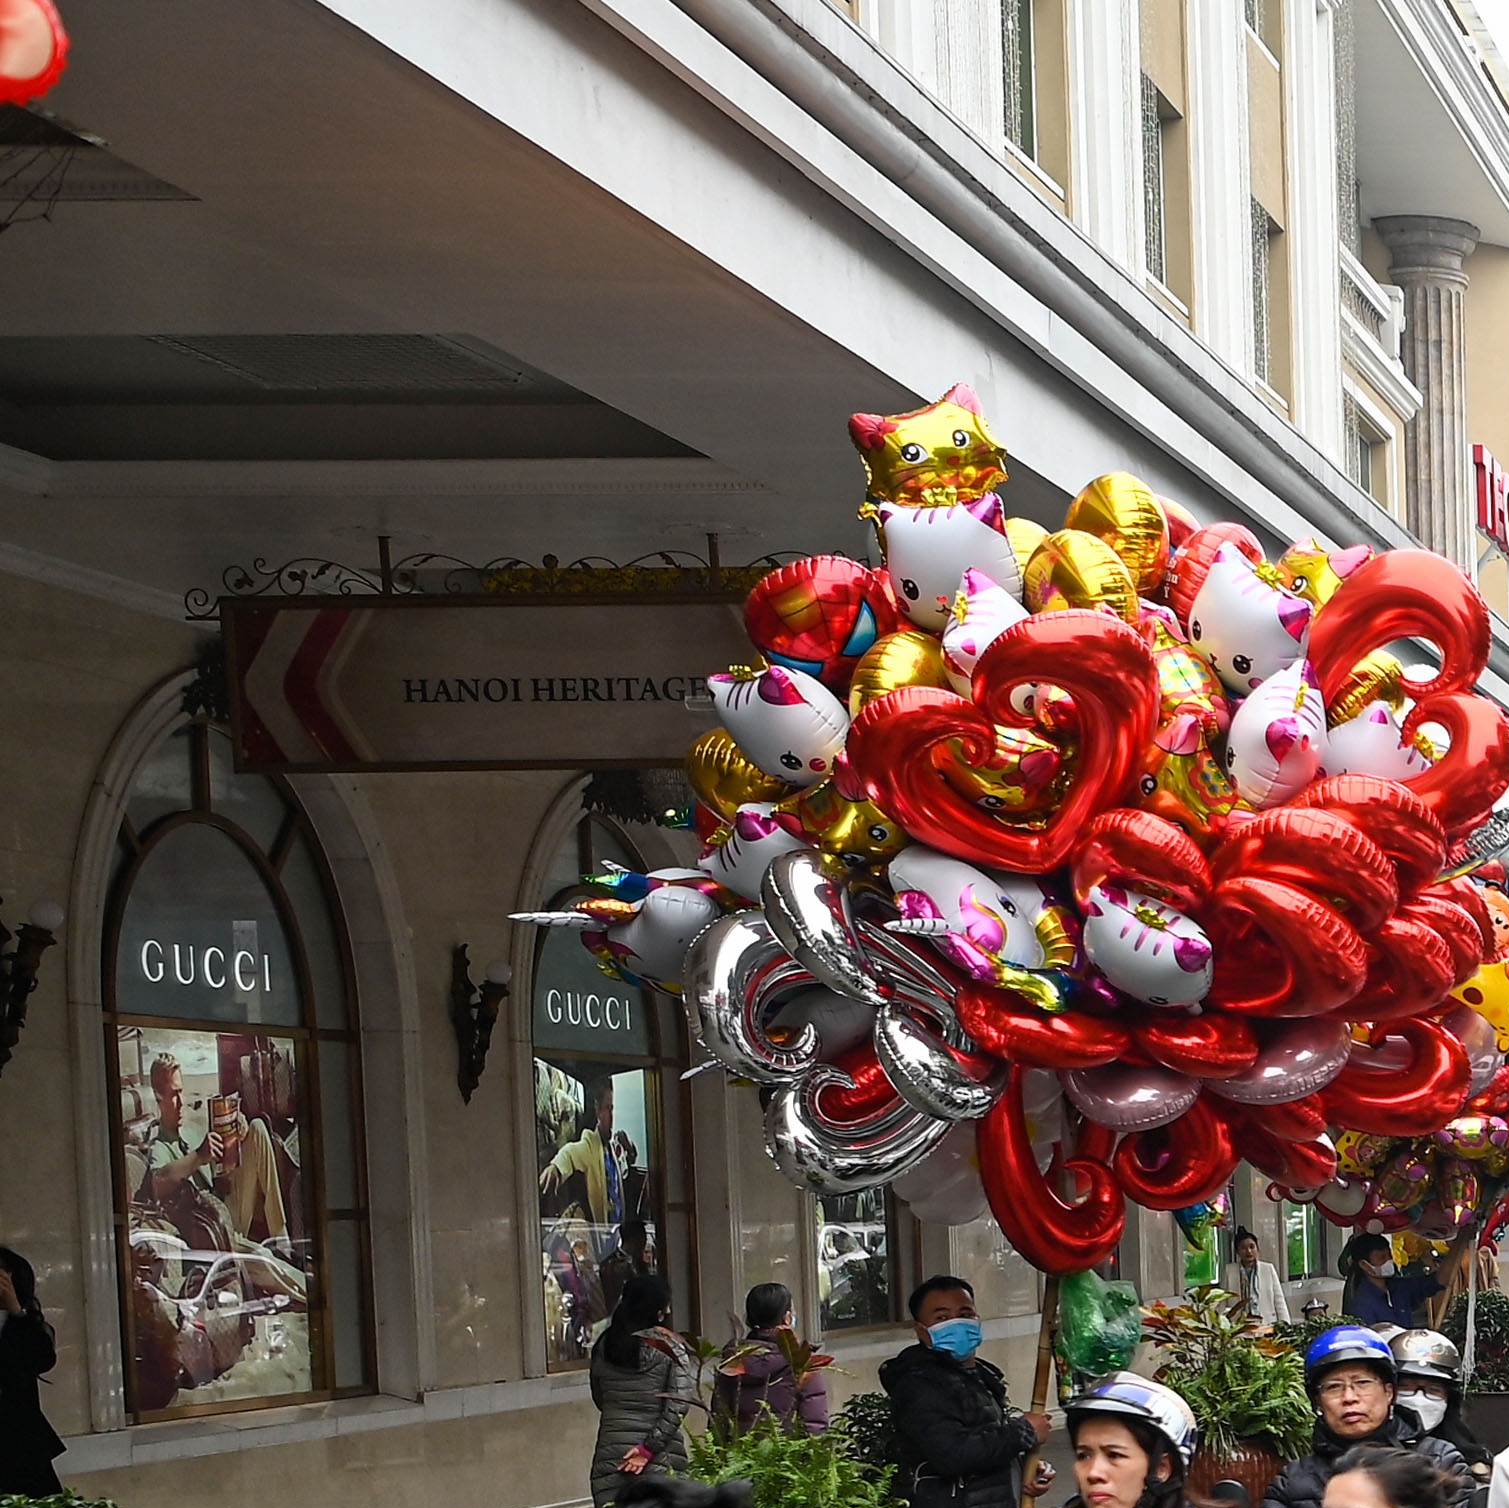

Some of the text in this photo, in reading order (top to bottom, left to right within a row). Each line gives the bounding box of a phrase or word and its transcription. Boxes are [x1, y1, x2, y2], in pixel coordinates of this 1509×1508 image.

[402, 676, 707, 703] HANOI HERITAGE
[141, 939, 271, 992] GUCCI
[547, 988, 631, 1031] GUCCI
